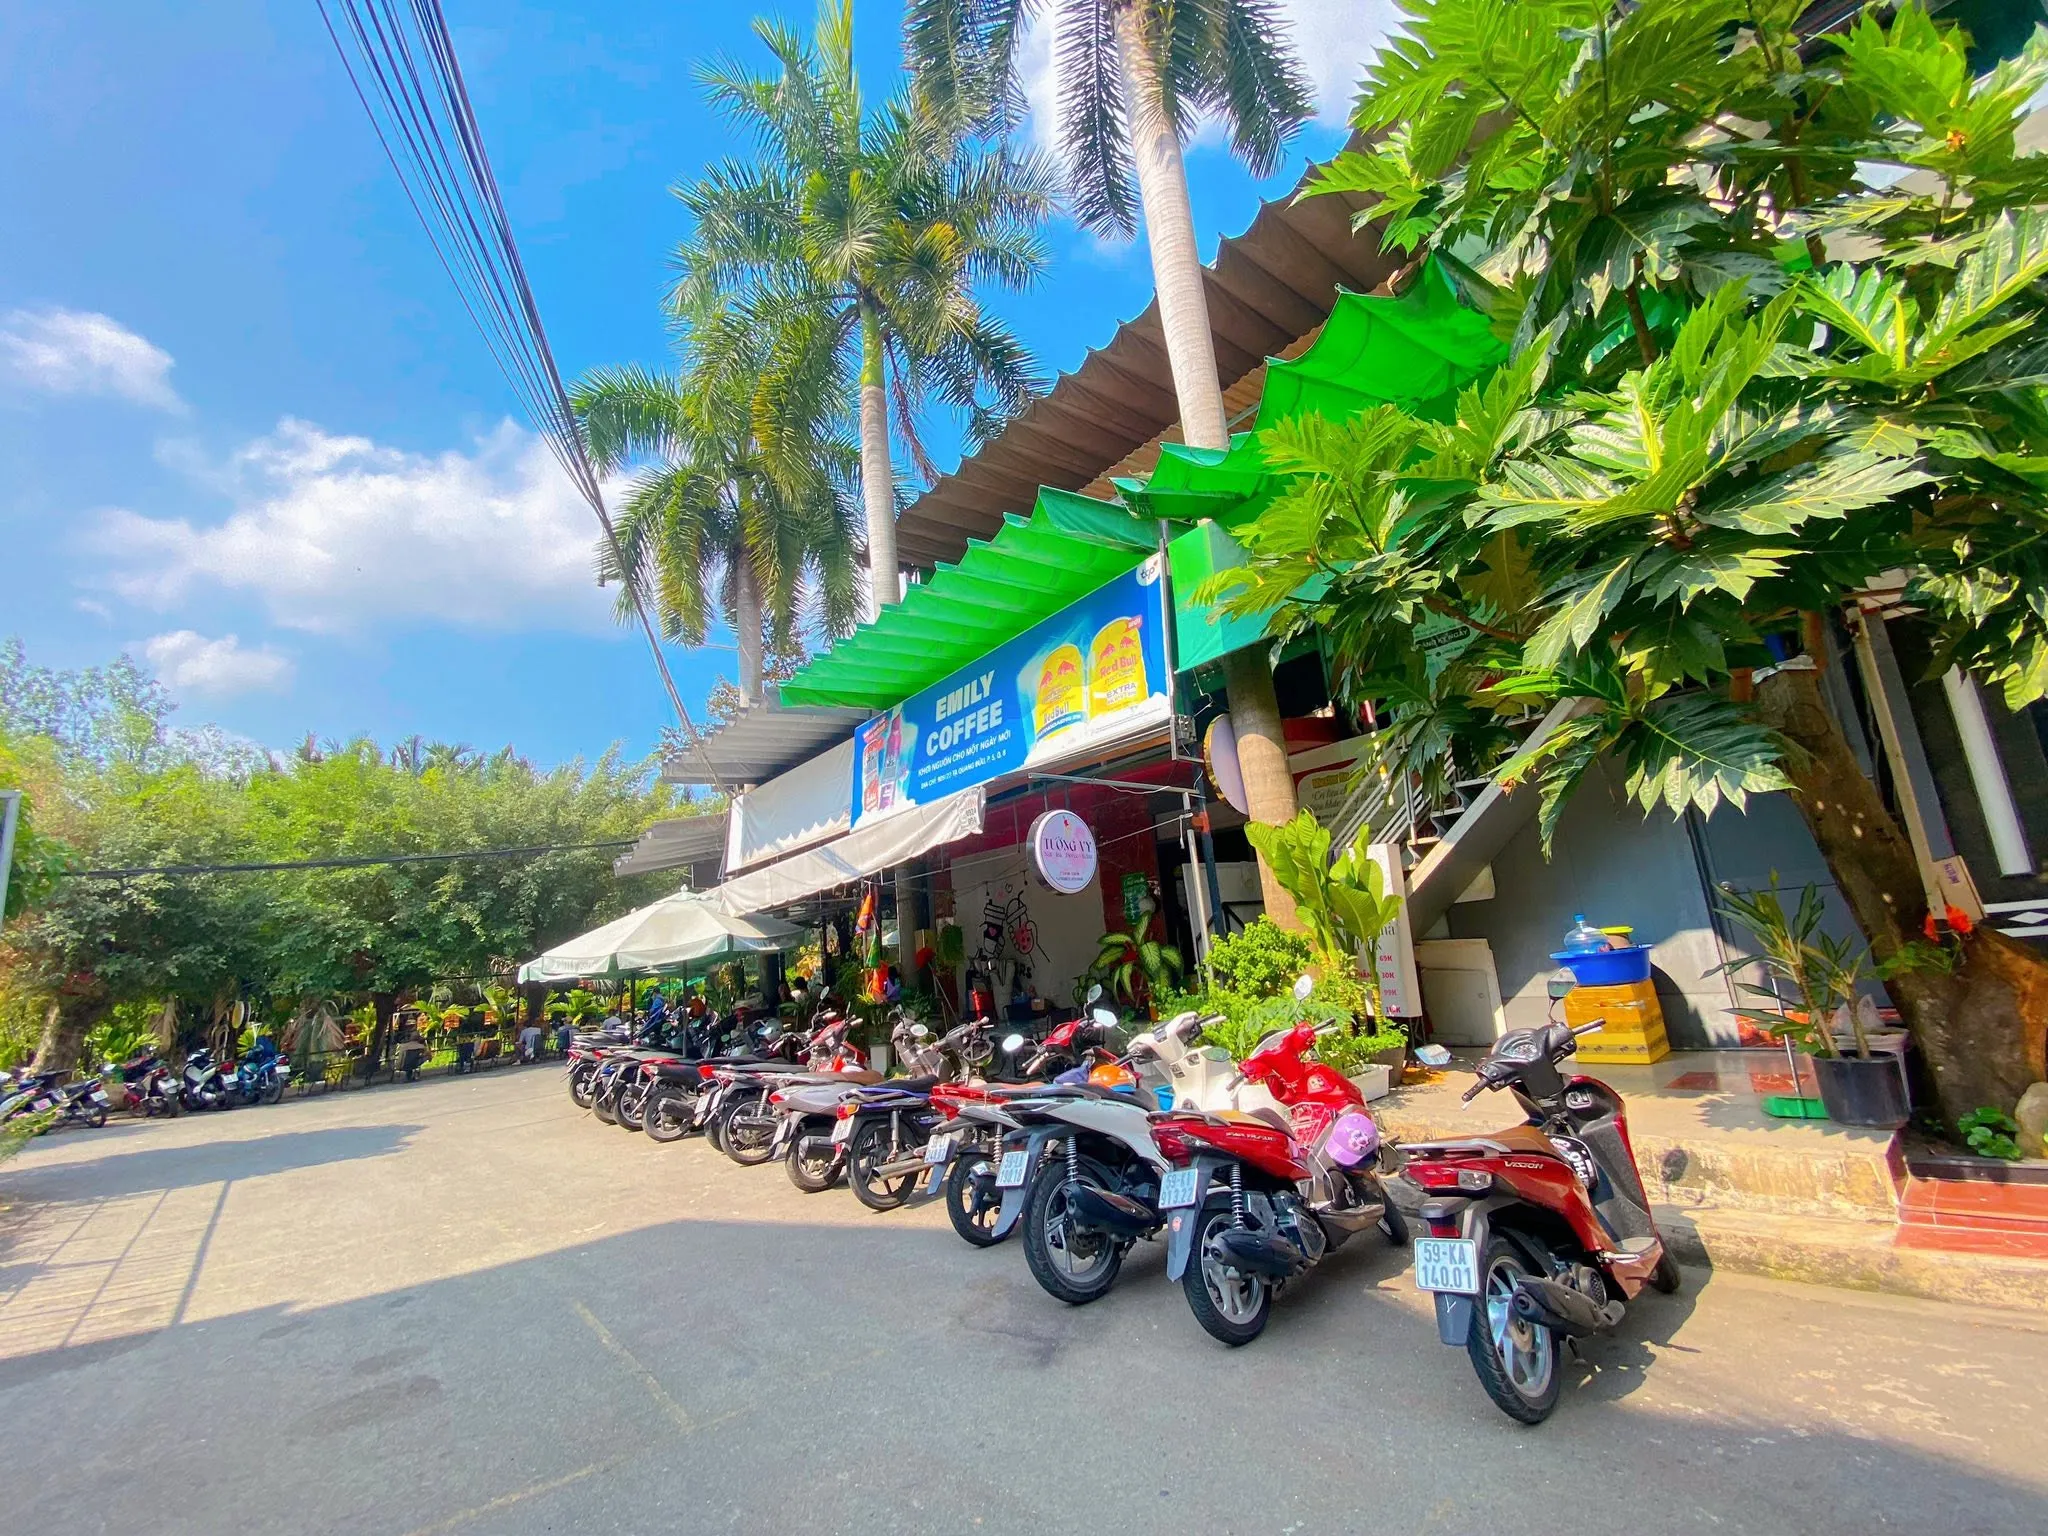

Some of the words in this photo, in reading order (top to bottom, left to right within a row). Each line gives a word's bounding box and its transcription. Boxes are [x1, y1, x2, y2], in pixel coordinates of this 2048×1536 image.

[1121, 654, 1137, 668] Bull
[936, 670, 995, 722] EMILY
[1107, 683, 1136, 698] EXTRA
[926, 699, 1003, 756] COFFEE
[952, 750, 965, 762] CHO
[980, 736, 997, 750] NGÀY
[1079, 840, 1092, 852] VY
[1504, 1160, 1544, 1170] VISION
[1424, 1242, 1466, 1265] 59-KA
[1422, 1264, 1472, 1289] 140.01
